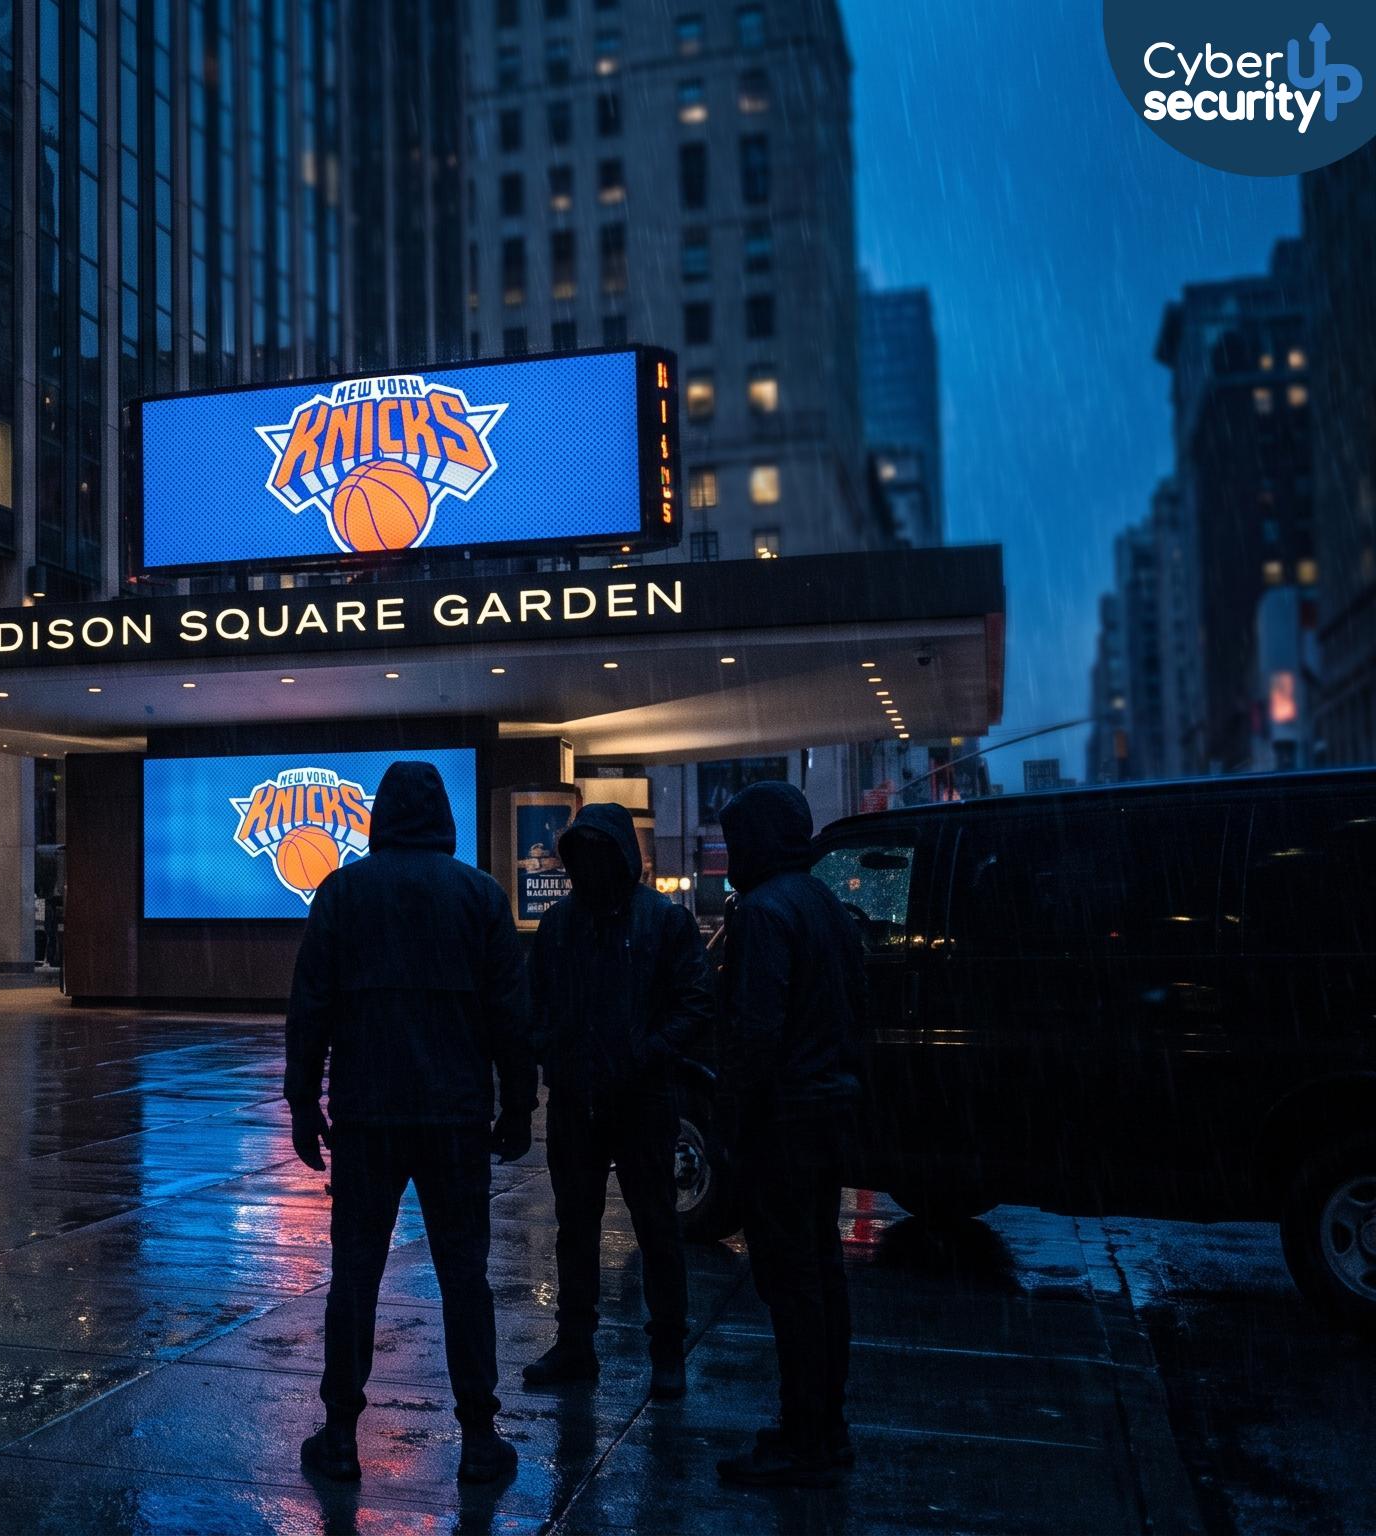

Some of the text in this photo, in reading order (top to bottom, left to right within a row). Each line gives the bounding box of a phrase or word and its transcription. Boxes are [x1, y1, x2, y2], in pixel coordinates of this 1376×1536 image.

[335, 378, 423, 404] NEW YORK
[274, 391, 491, 492] KNICKS
[179, 598, 405, 642] SQUARE
[433, 580, 683, 627] GARDEN
[280, 772, 304, 786] NEW
[238, 784, 371, 841] KNICKS
